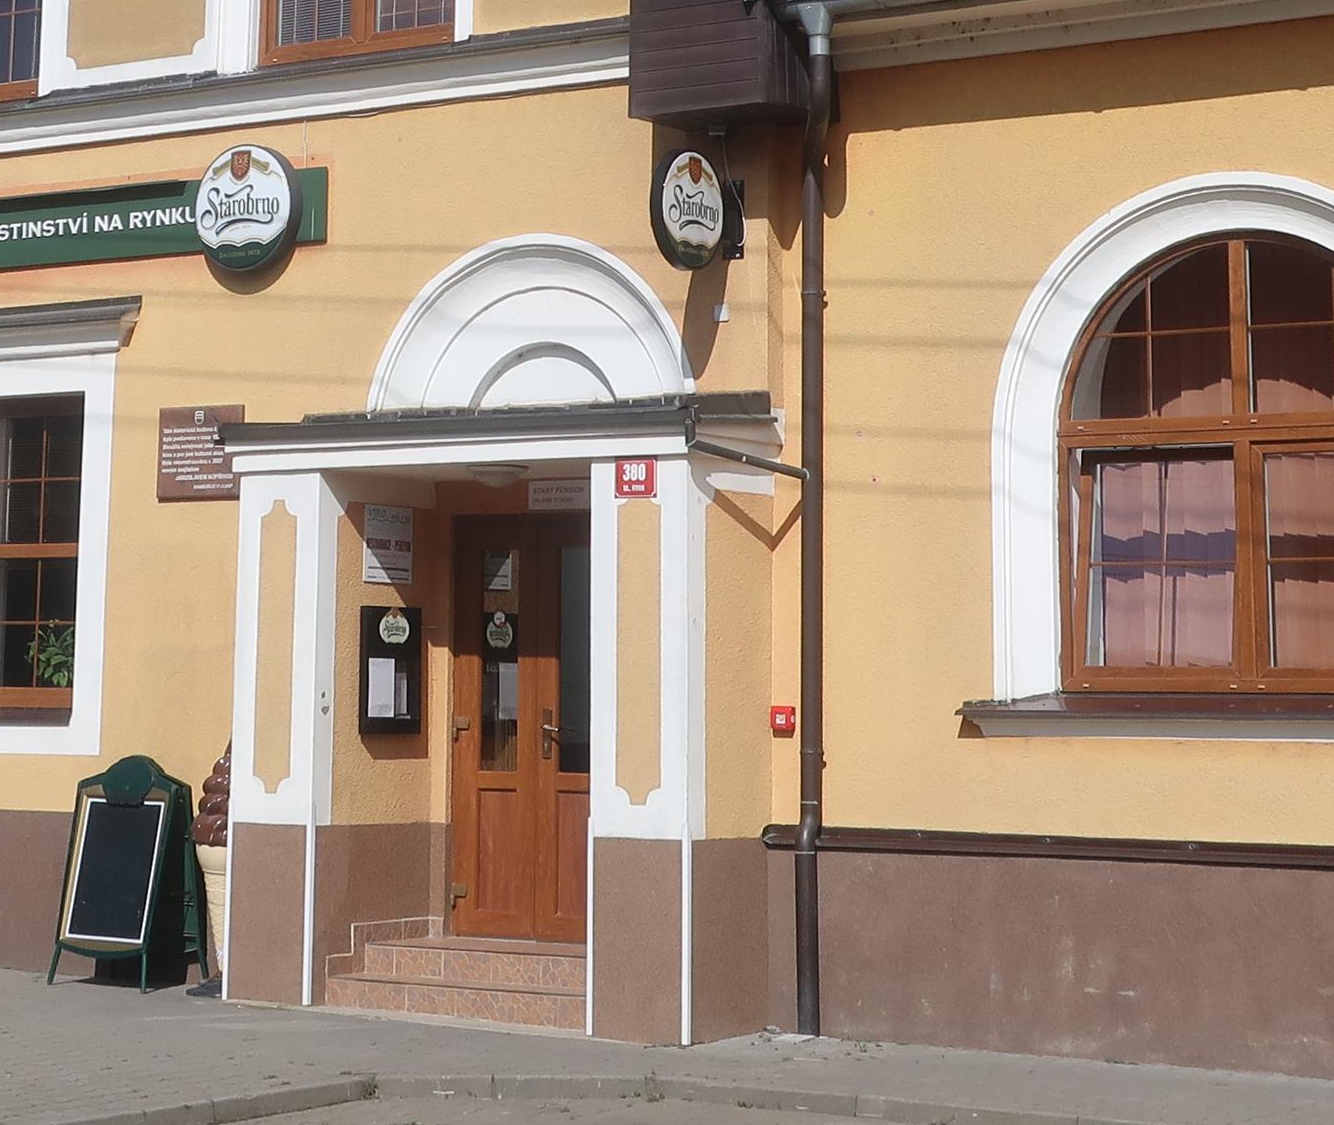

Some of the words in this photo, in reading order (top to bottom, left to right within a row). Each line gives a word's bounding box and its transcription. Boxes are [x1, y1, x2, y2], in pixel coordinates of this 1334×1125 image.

[94, 213, 124, 233] NA
[200, 184, 280, 236] Starobrno
[668, 184, 719, 231] Starobrno
[622, 463, 646, 481] 380
